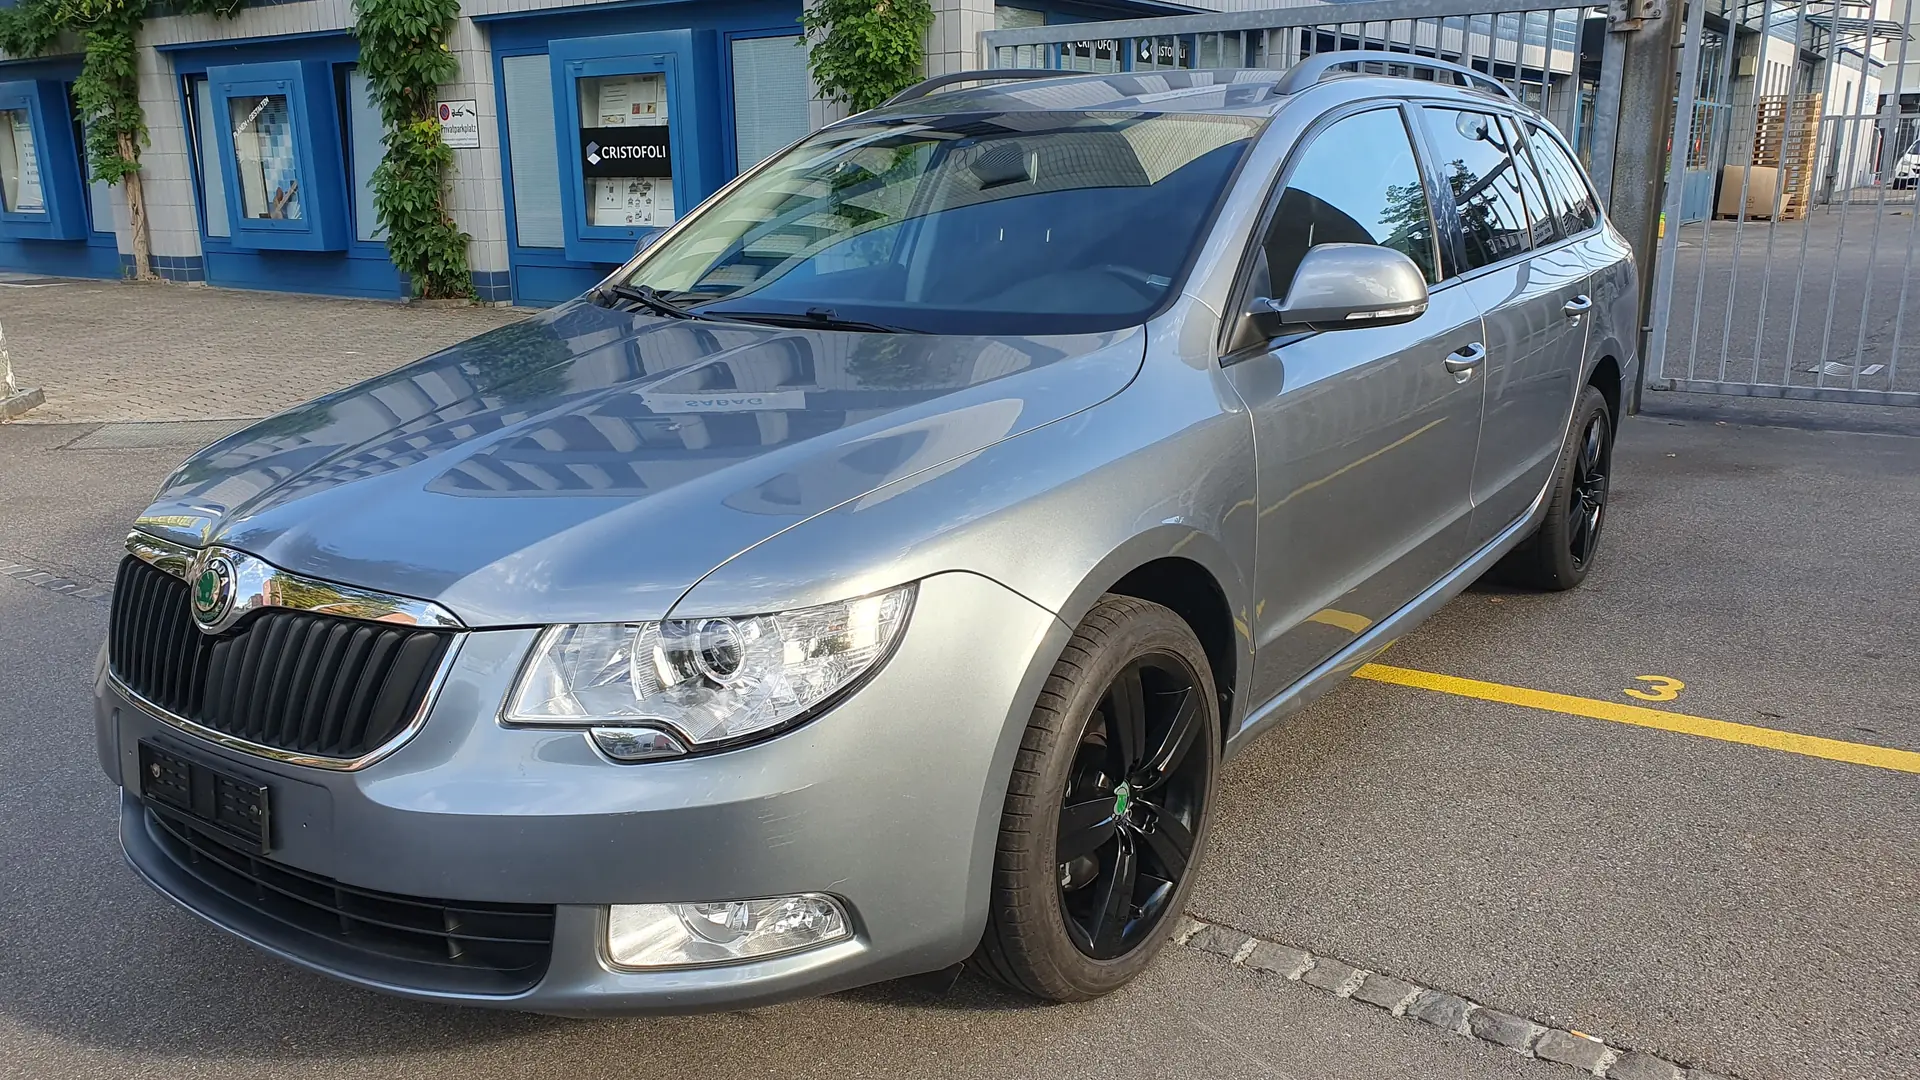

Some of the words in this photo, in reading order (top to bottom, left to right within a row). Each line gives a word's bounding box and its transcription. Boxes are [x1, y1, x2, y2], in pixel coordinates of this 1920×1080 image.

[1077, 40, 1118, 52] CRIOFOI
[1150, 45, 1186, 59] CISTOLI
[440, 123, 477, 134] Privatparkplatz
[601, 145, 666, 159] CRISTOFOLI
[1624, 675, 1685, 701] 3
